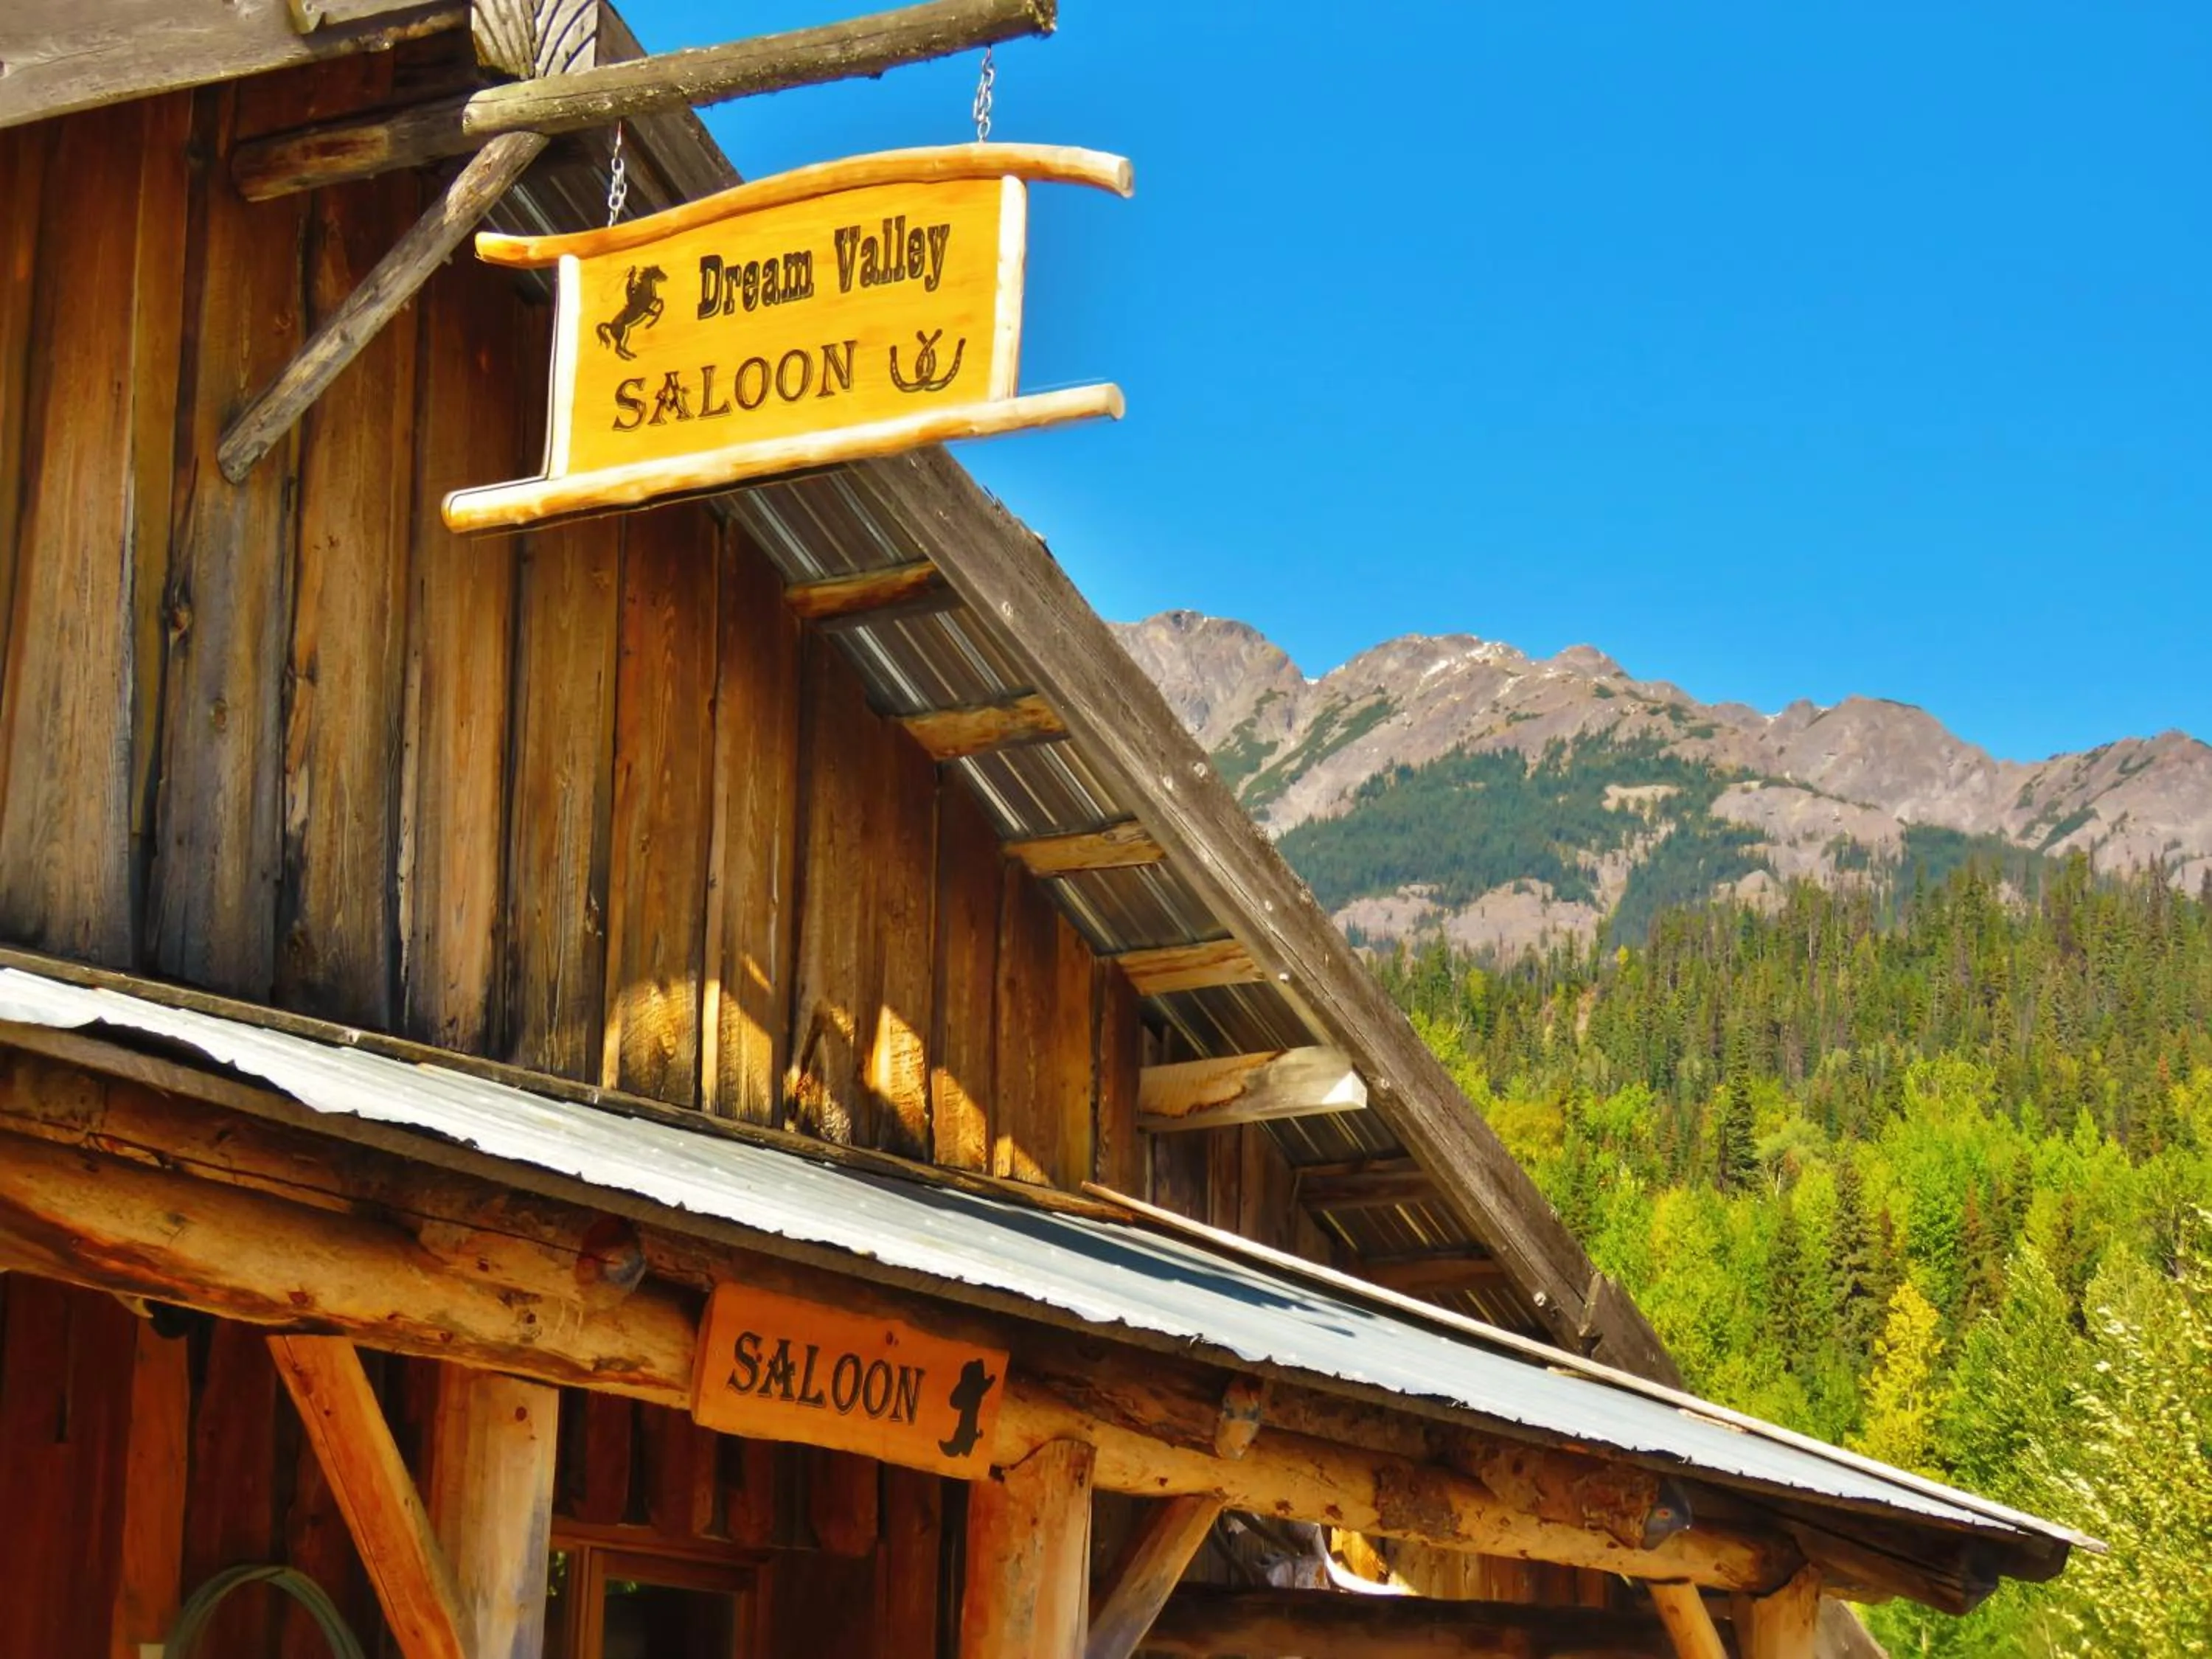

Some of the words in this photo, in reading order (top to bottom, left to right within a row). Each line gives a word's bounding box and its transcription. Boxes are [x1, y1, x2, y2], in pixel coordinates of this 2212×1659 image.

[698, 249, 815, 321] Dream
[834, 215, 950, 293] Valley
[612, 339, 858, 431] SALOON
[727, 1331, 926, 1426] SALOON
